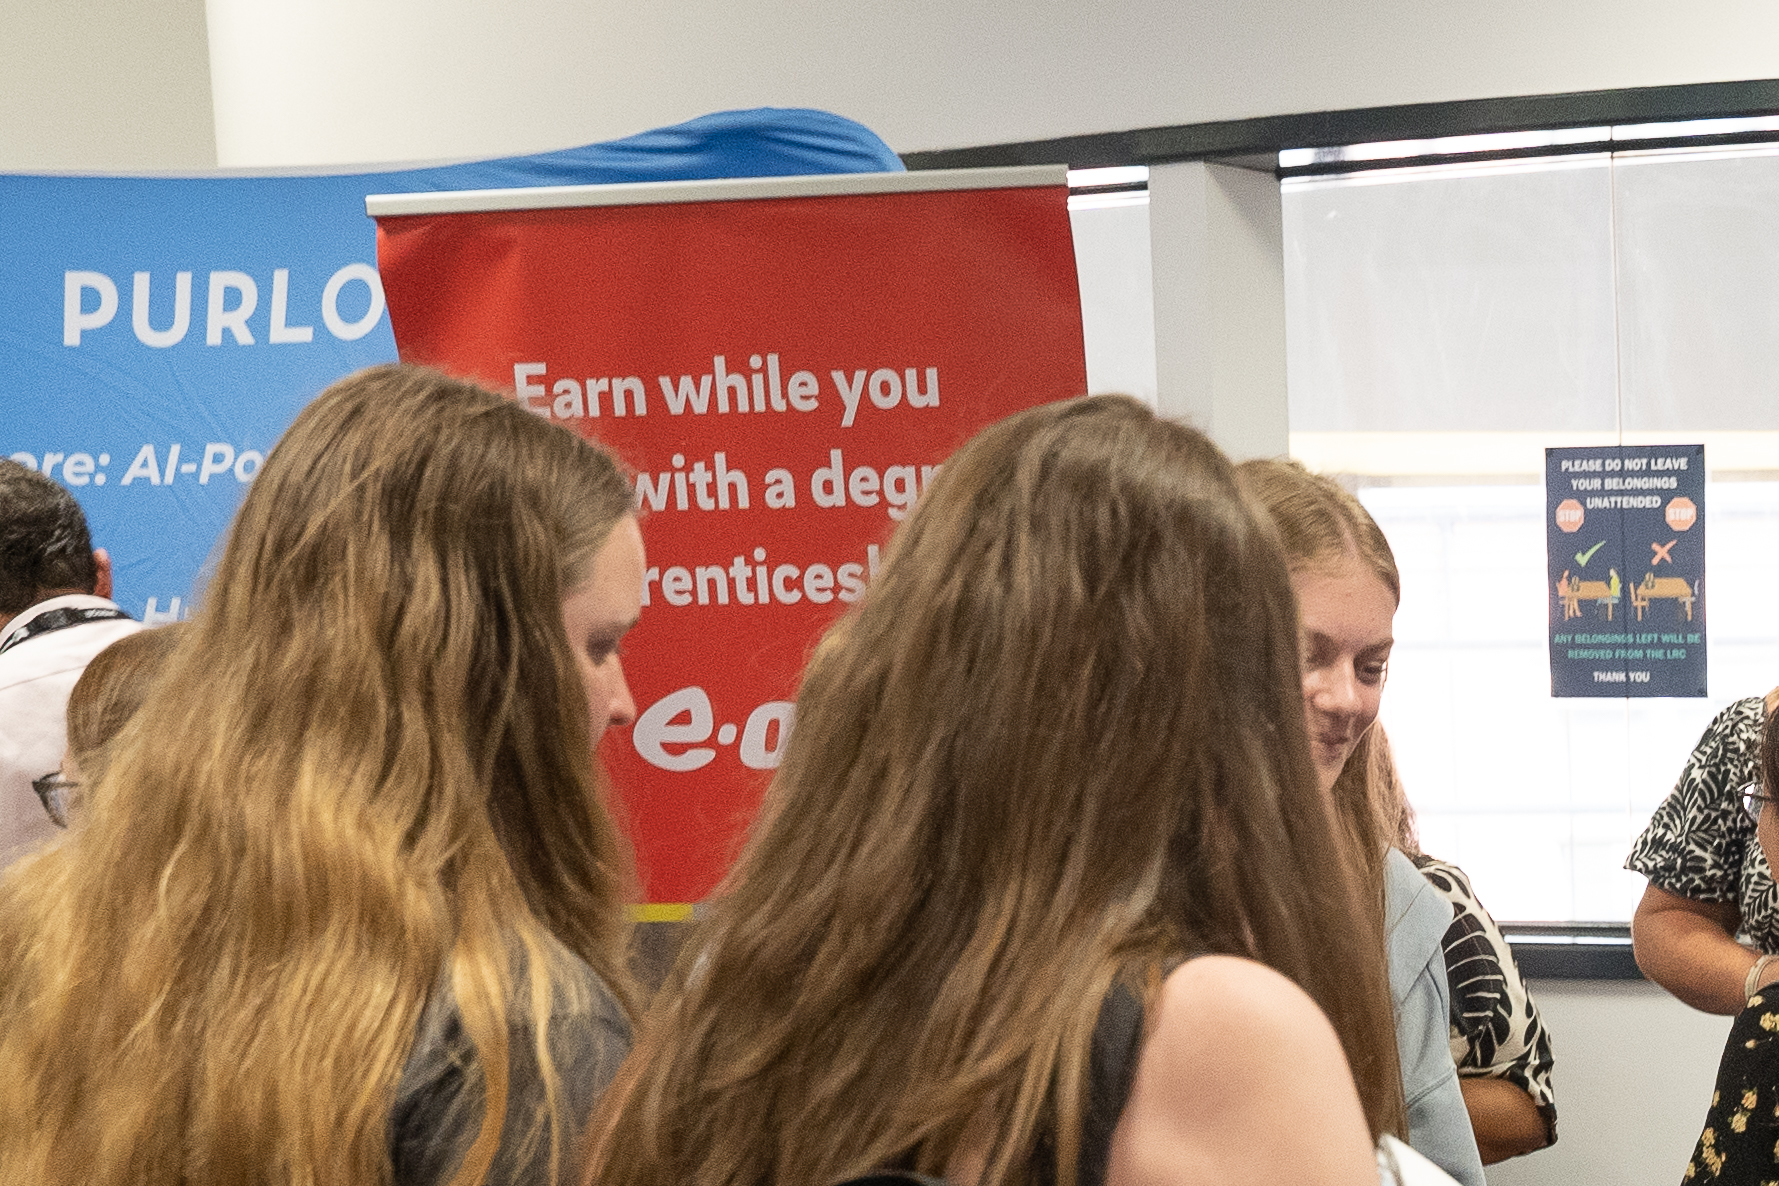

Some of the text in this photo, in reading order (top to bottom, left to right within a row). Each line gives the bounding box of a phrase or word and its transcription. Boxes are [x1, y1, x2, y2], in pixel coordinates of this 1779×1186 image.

[63, 264, 385, 347] PURLO
[513, 353, 941, 428] Earn while you
[1561, 458, 1688, 472] PLEASE DO NOT LEAVE
[764, 467, 796, 509] a
[1571, 476, 1677, 491] YOUR BELONGINGS
[1587, 496, 1661, 509] UNATTENDED
[1559, 509, 1582, 522] STOP
[1669, 507, 1693, 521] STOP
[1636, 633, 1658, 643] LEFT
[1662, 633, 1685, 643] WILL
[1647, 648, 1664, 659] THE
[1593, 671, 1650, 682] THANK YOU
